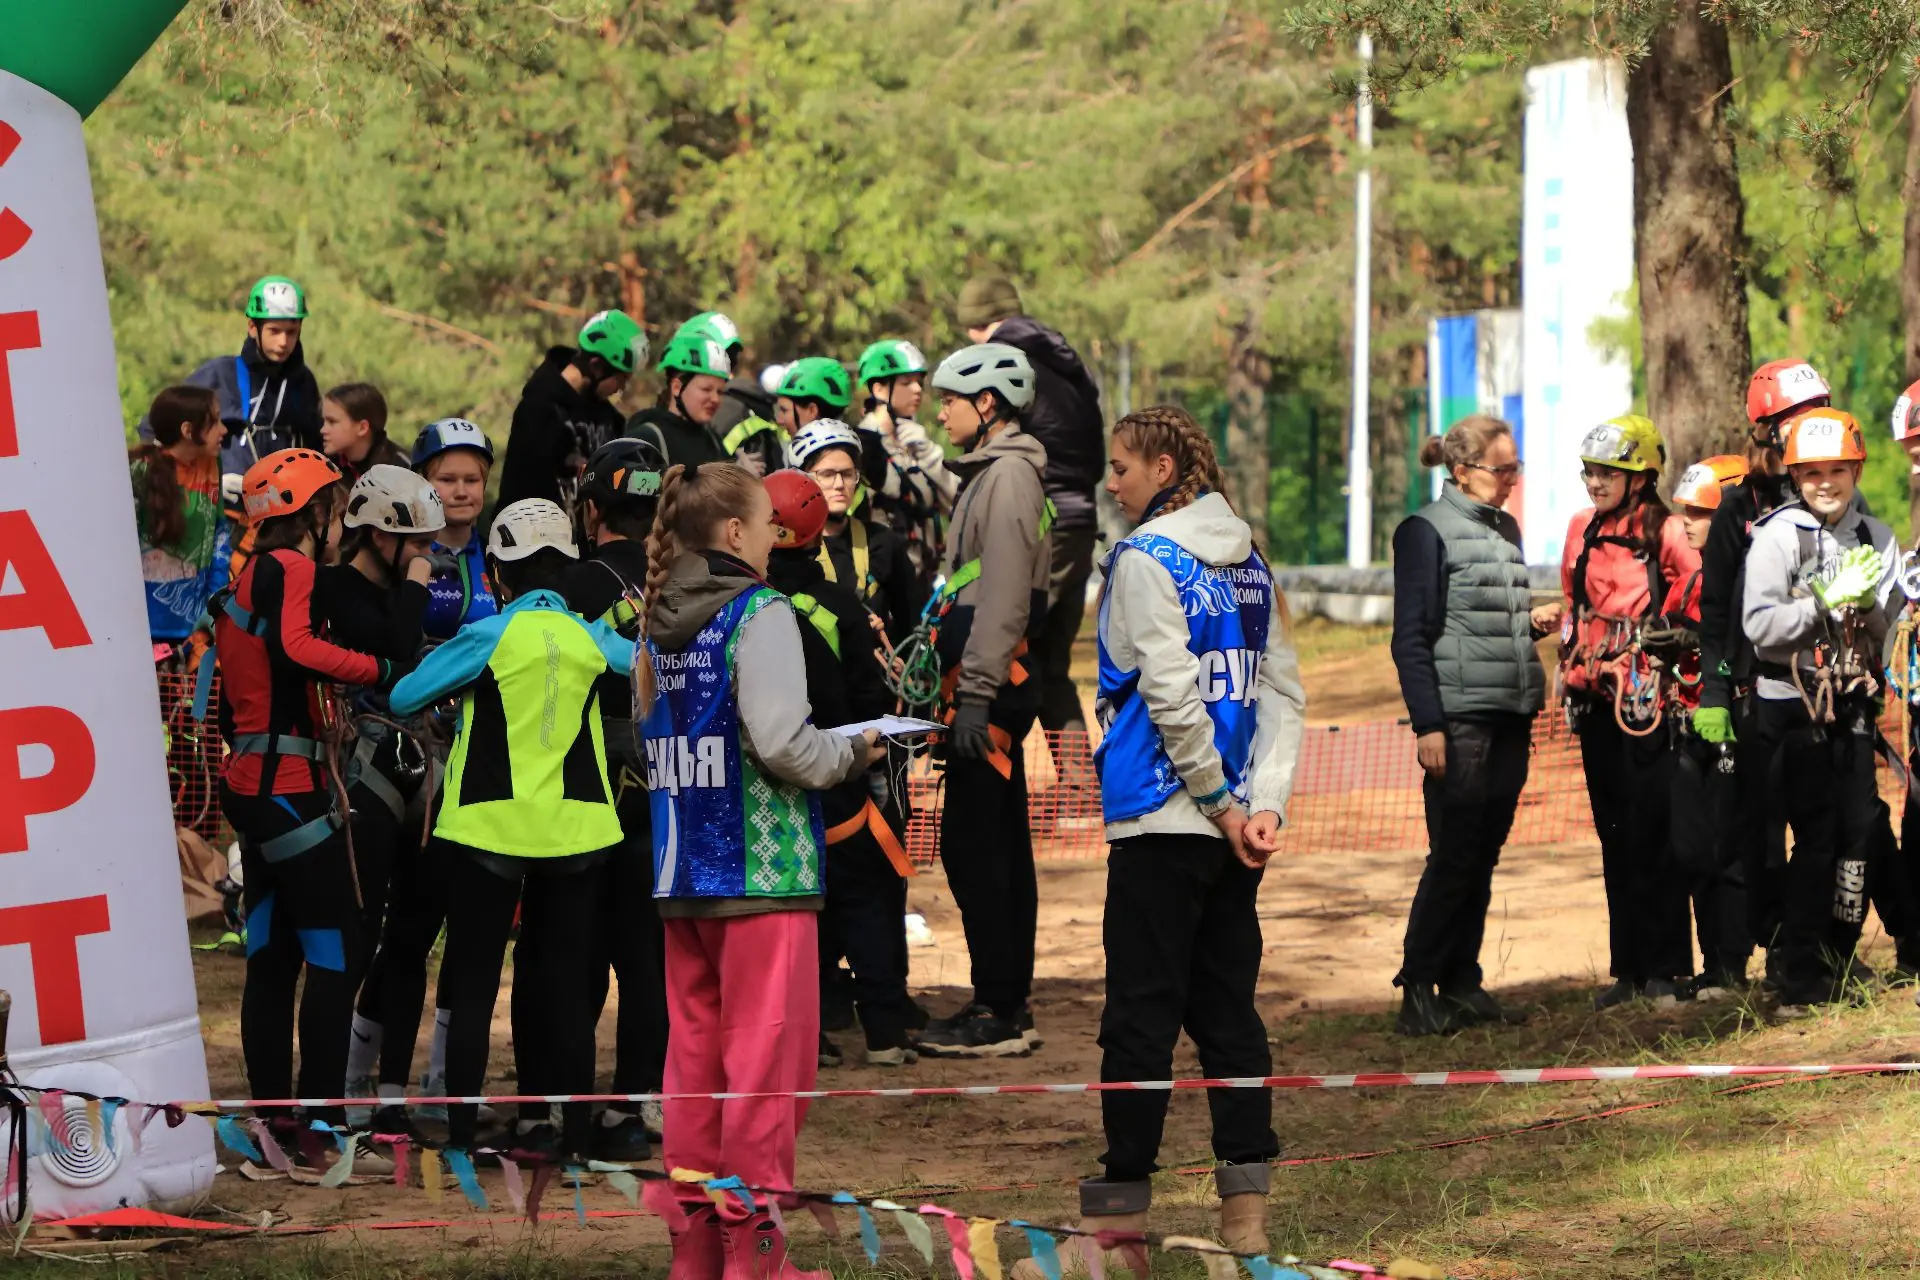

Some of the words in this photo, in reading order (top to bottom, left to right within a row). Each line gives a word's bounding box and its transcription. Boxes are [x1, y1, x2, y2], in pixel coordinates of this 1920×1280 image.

[270, 286, 288, 295] 17
[448, 421, 474, 432] 19
[1807, 423, 1833, 436] 20
[1587, 427, 1609, 442] 20
[1198, 648, 1261, 708] СУД
[540, 629, 560, 751] FISCHER
